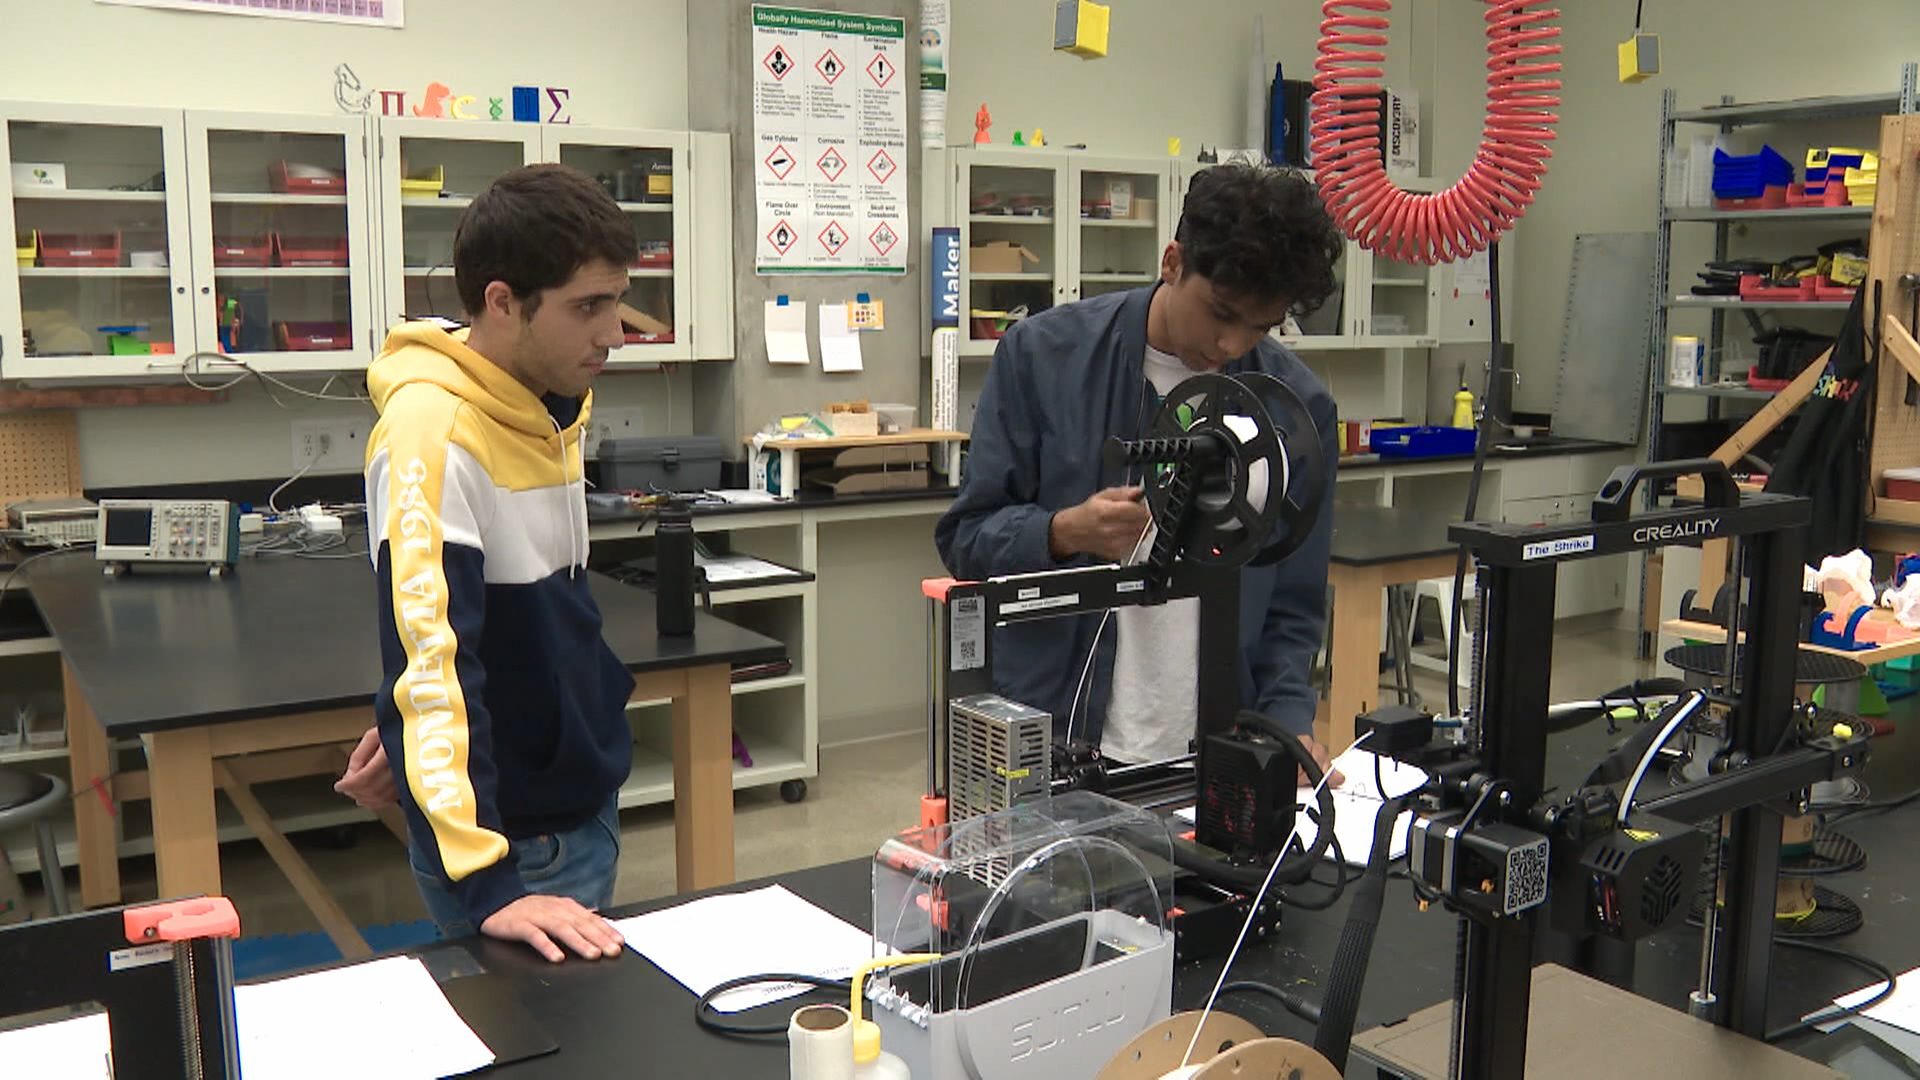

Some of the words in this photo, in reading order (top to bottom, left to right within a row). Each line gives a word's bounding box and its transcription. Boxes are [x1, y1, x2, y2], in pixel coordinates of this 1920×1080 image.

[757, 11, 789, 25] Globally
[790, 14, 836, 27] Harmonized
[837, 19, 865, 30] System
[866, 21, 897, 33] Symbols
[761, 134, 773, 142] Gas
[774, 135, 798, 143] Cylinder
[859, 138, 887, 148] Exploding
[867, 211, 900, 219] Crossbones
[942, 236, 960, 317] Maker
[397, 457, 432, 554] 1986
[1633, 518, 1720, 543] CREALITY
[1526, 544, 1549, 556] The
[1554, 540, 1590, 553] Shrike
